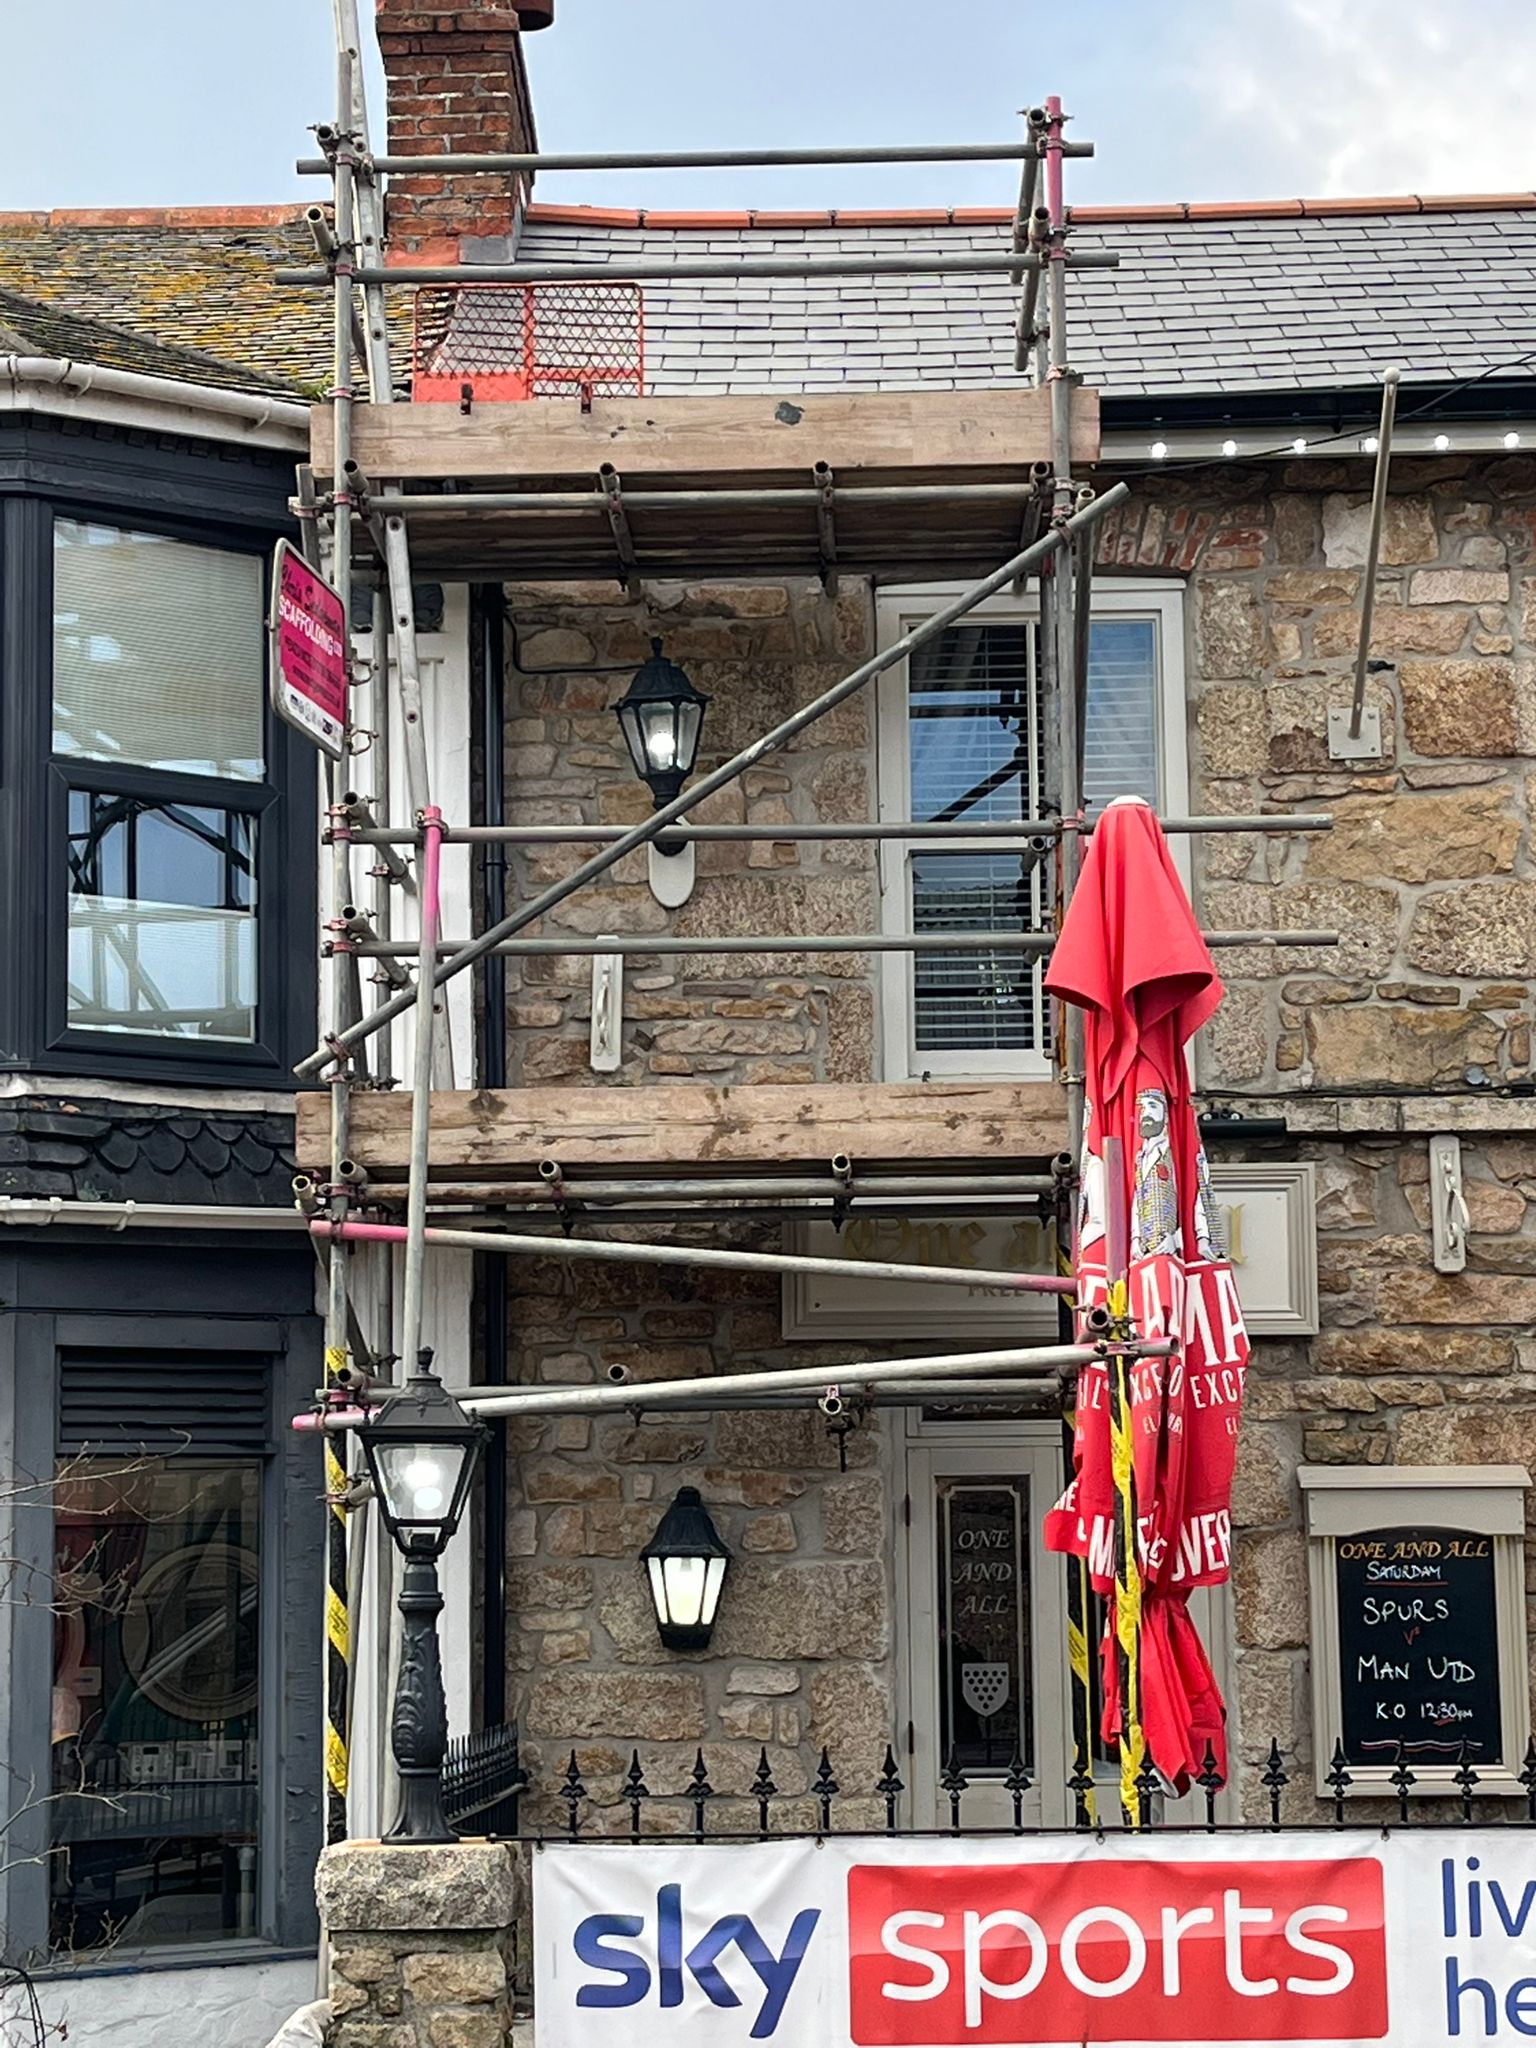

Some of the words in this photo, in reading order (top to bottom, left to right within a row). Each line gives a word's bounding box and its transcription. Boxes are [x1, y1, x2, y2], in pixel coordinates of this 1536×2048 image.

[278, 595, 334, 656] SCAFFOLDING
[958, 1529, 1010, 1550] ONE
[1340, 1541, 1388, 1560] ONE
[1389, 1541, 1442, 1561] AND
[1442, 1541, 1490, 1559] ALL
[953, 1562, 1012, 1584] AND
[958, 1595, 1010, 1616] ALL
[1363, 1597, 1450, 1625] SPURS
[1357, 1655, 1410, 1683] MAN
[573, 1882, 822, 2039] sky
[880, 1888, 1355, 2028] sports
